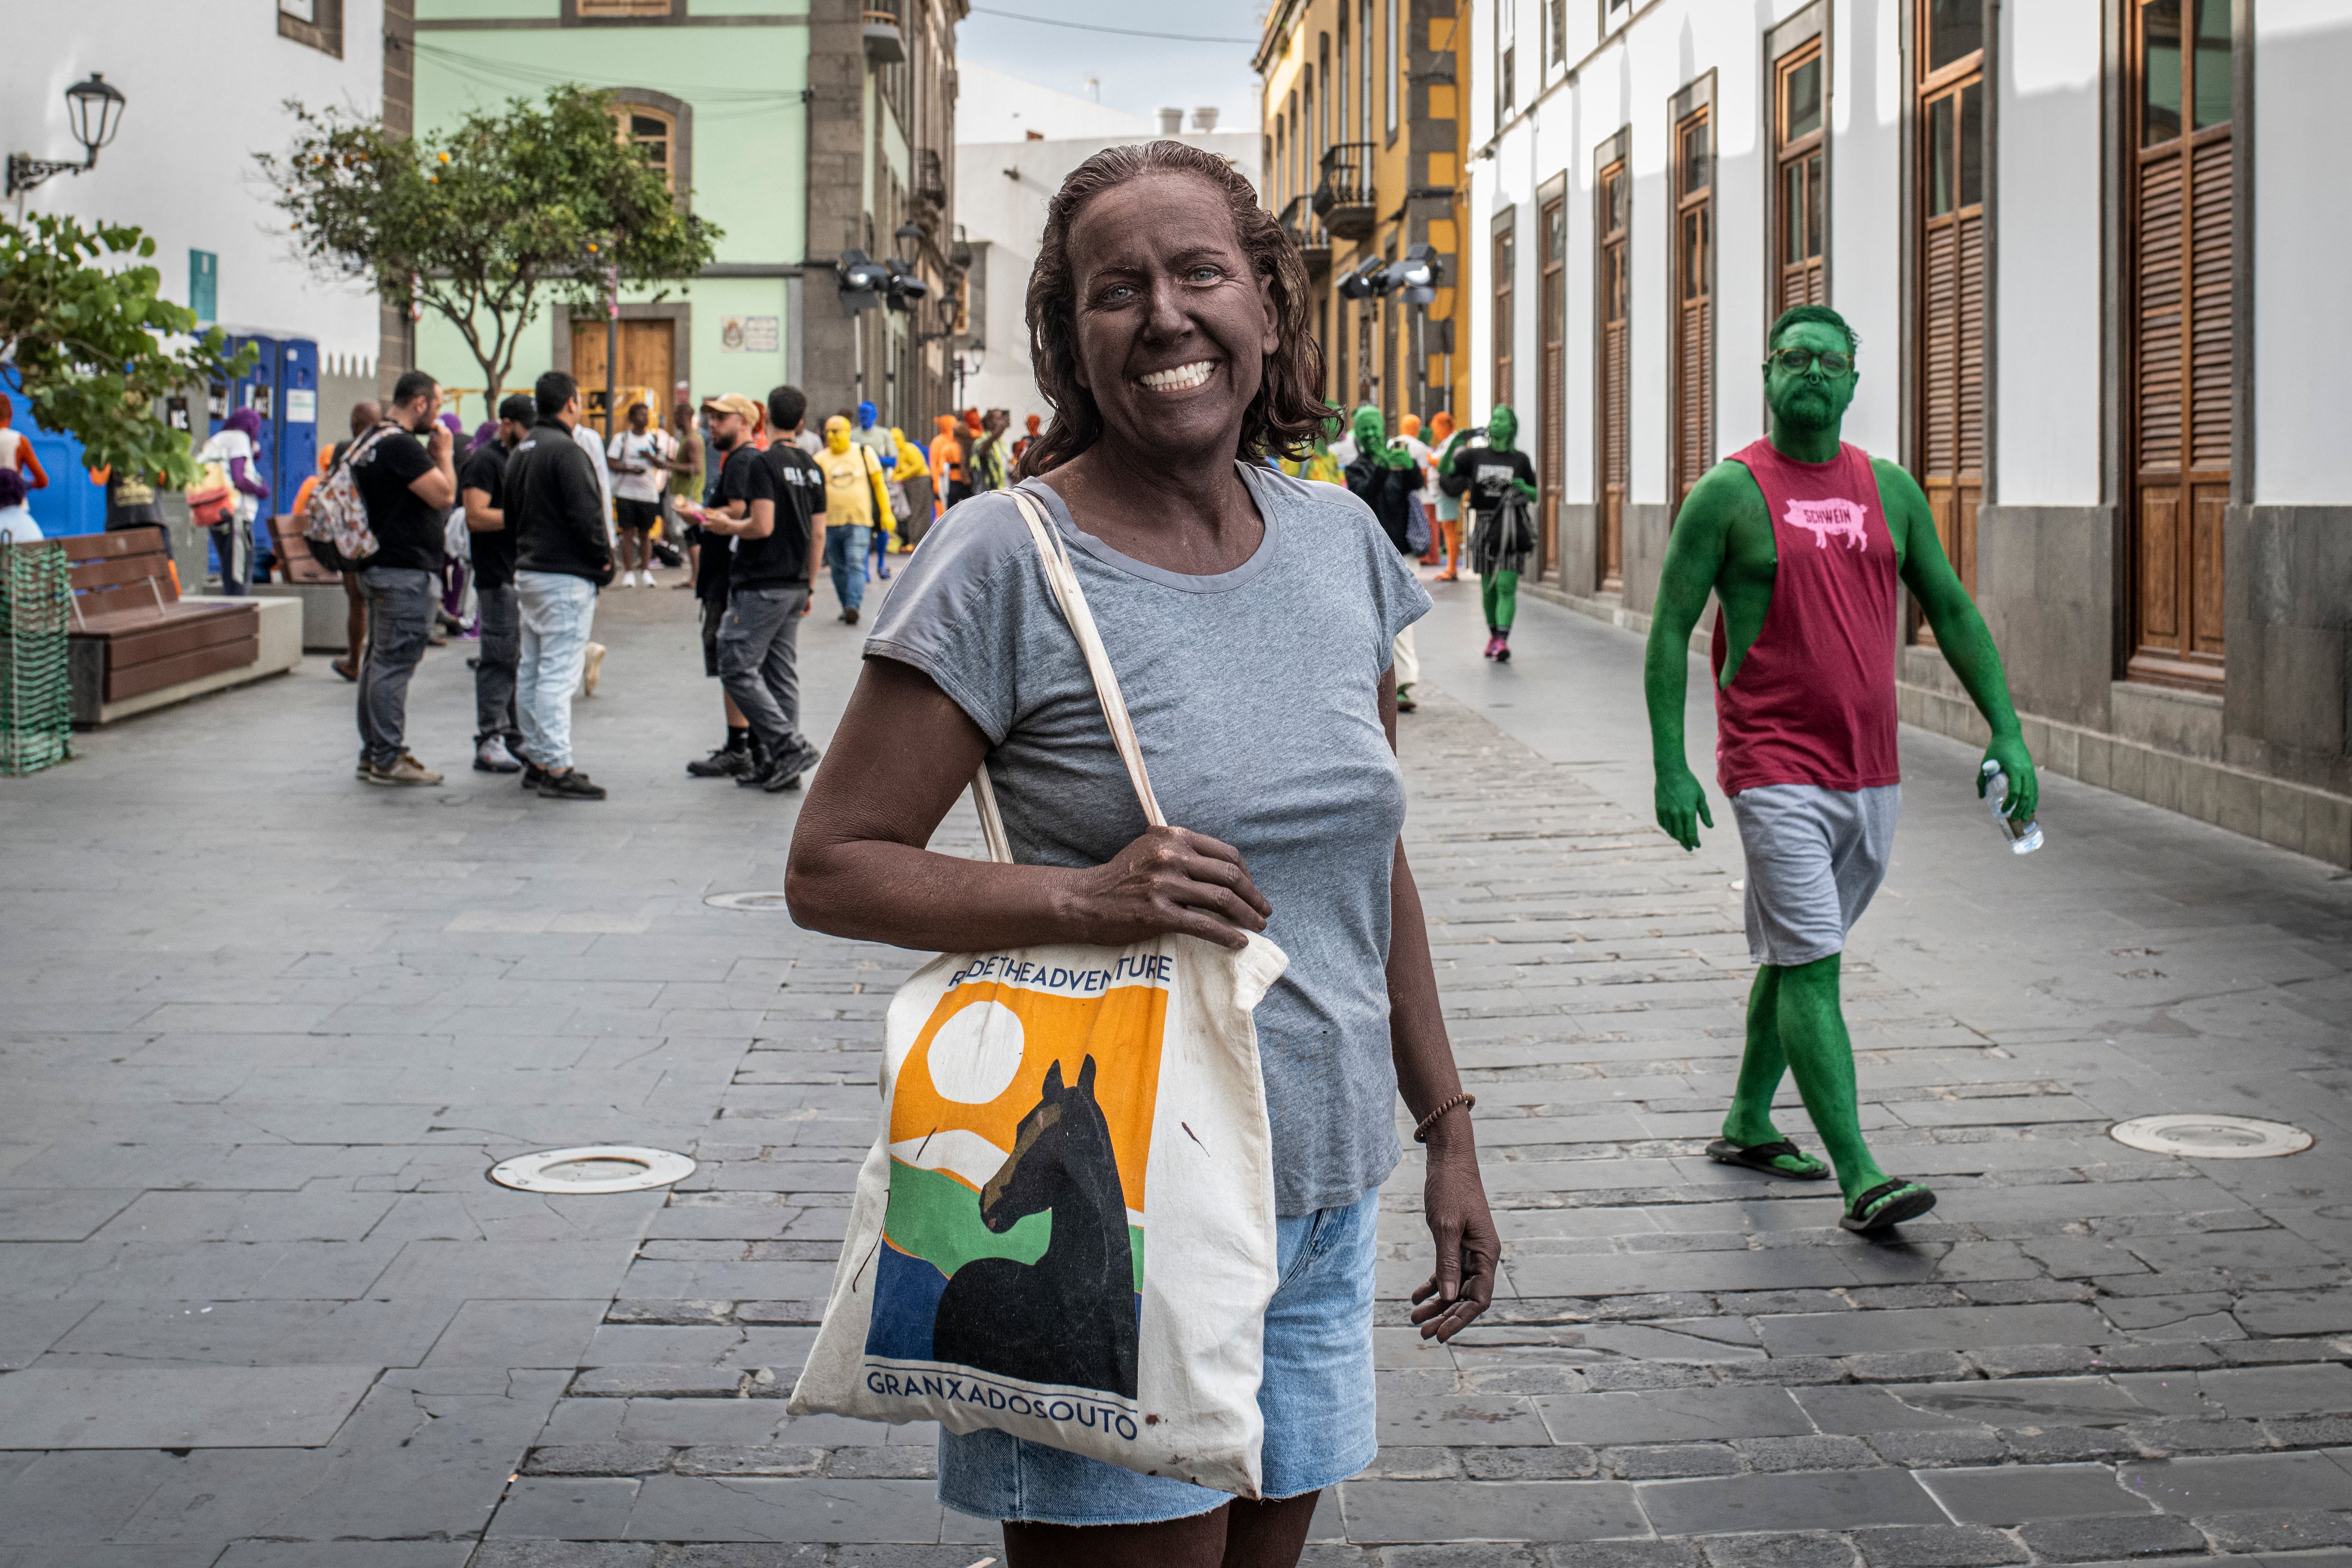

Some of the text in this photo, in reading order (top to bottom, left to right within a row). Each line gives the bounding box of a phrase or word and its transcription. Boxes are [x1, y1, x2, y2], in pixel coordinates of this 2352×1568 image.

[1804, 509, 1851, 524] SCHWEIN
[948, 954, 1173, 991] RDETHEADVENTURE
[867, 1371, 1137, 1441] GRANXADOSOUTO
